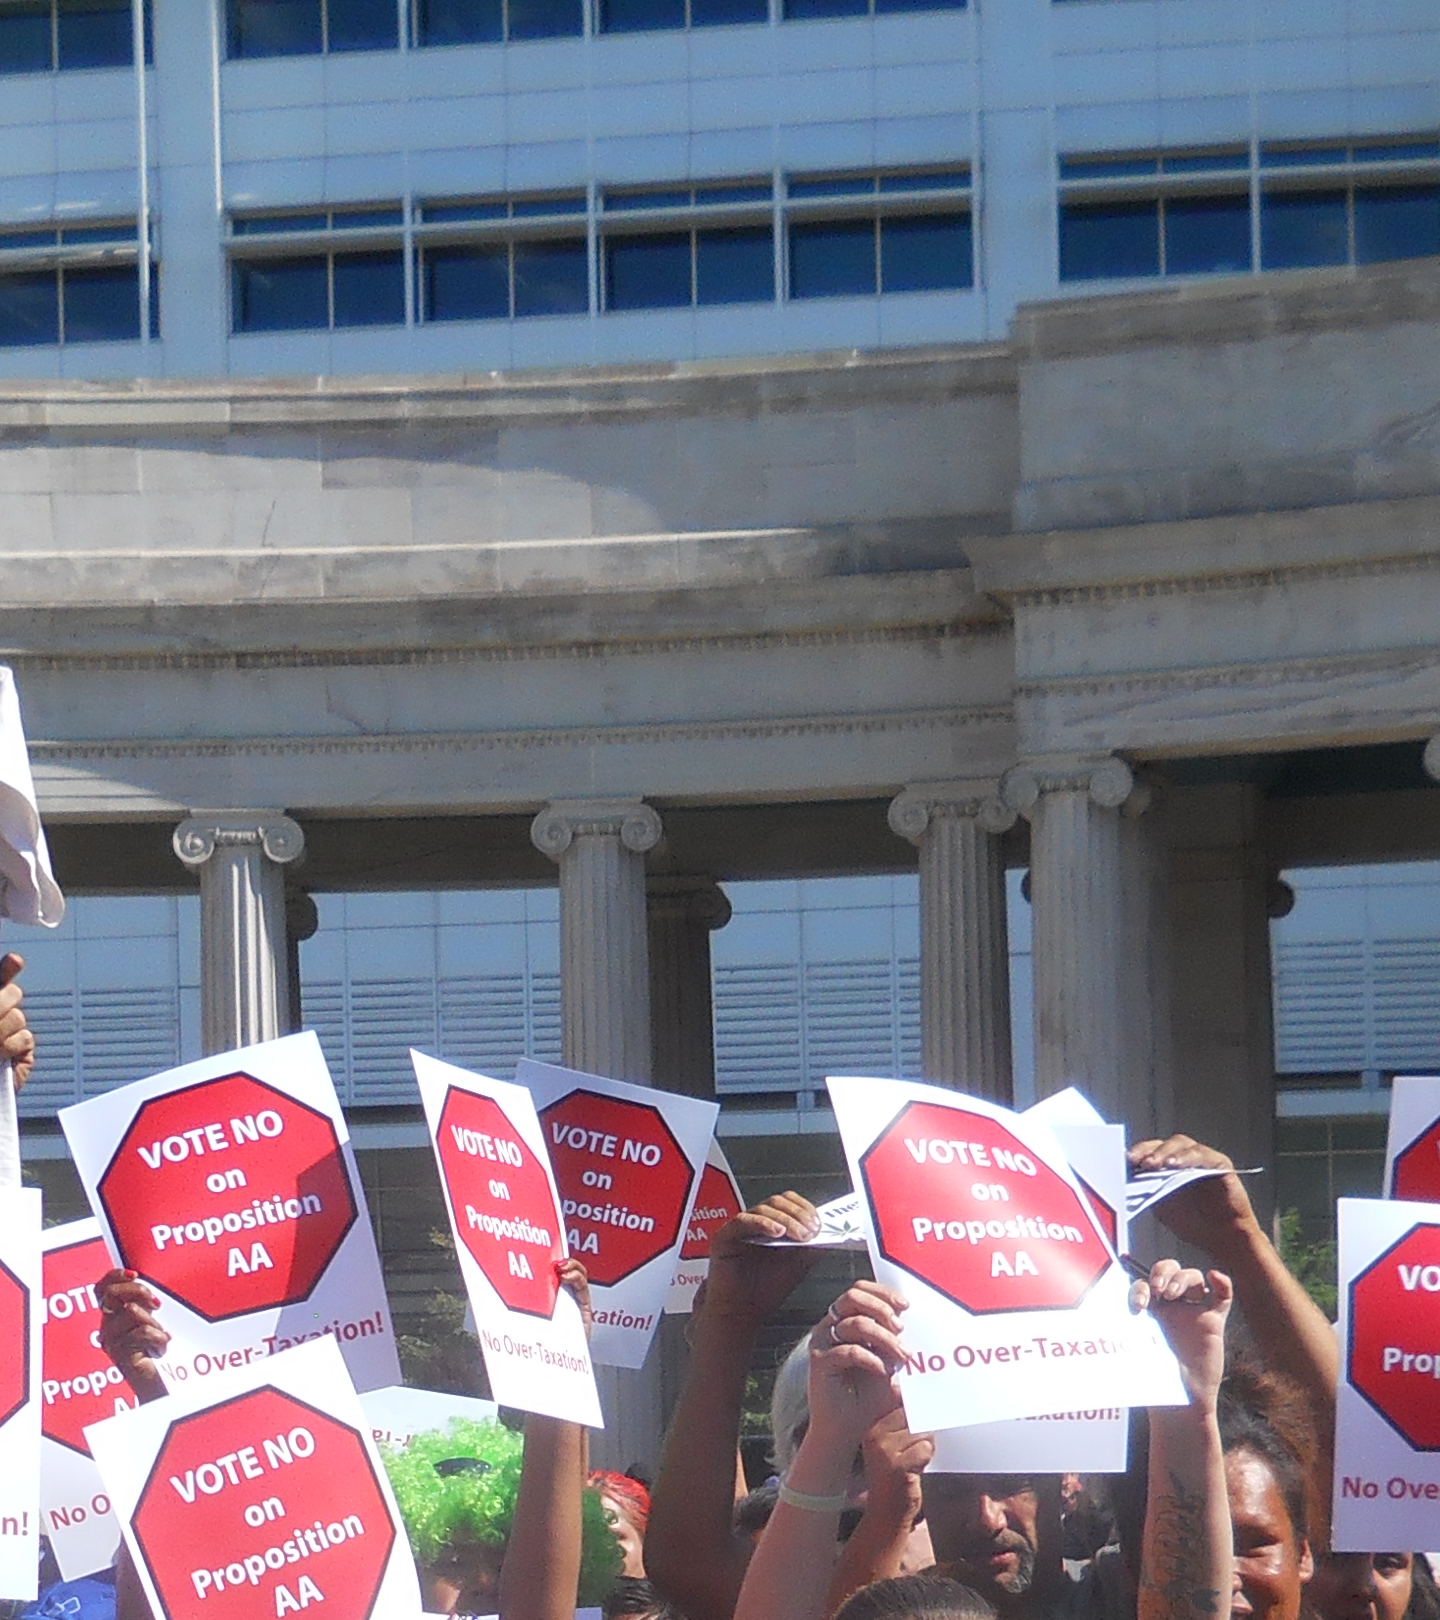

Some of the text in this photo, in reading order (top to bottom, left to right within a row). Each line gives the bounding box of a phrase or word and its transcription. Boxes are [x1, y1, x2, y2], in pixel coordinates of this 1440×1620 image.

[137, 1110, 284, 1169] VOTE NO
[450, 1125, 522, 1167] VOTE NO
[551, 1122, 661, 1167] VOTE NO
[904, 1138, 1037, 1176] VOTE NO
[206, 1167, 247, 1193] on
[488, 1179, 510, 1201] on
[582, 1171, 612, 1190] on
[971, 1181, 1009, 1202] on
[150, 1193, 322, 1251] Proposition
[465, 1204, 551, 1248] Proposition
[562, 1199, 655, 1233] position
[912, 1215, 1084, 1245] Proposition
[567, 1228, 599, 1255] AA
[687, 1230, 708, 1241] AA
[227, 1242, 274, 1277] AA
[508, 1251, 533, 1280] AA
[990, 1251, 1039, 1278] AA
[482, 1329, 590, 1375] No Over-Taxation!
[905, 1352, 946, 1377] No
[161, 1363, 188, 1381] No
[169, 1453, 261, 1505] VOTE
[262, 1426, 316, 1471] NO
[1342, 1476, 1379, 1499] No
[49, 1506, 87, 1530] No
[244, 1495, 286, 1527] on
[191, 1514, 365, 1599] Proposition
[273, 1576, 325, 1618] AA
